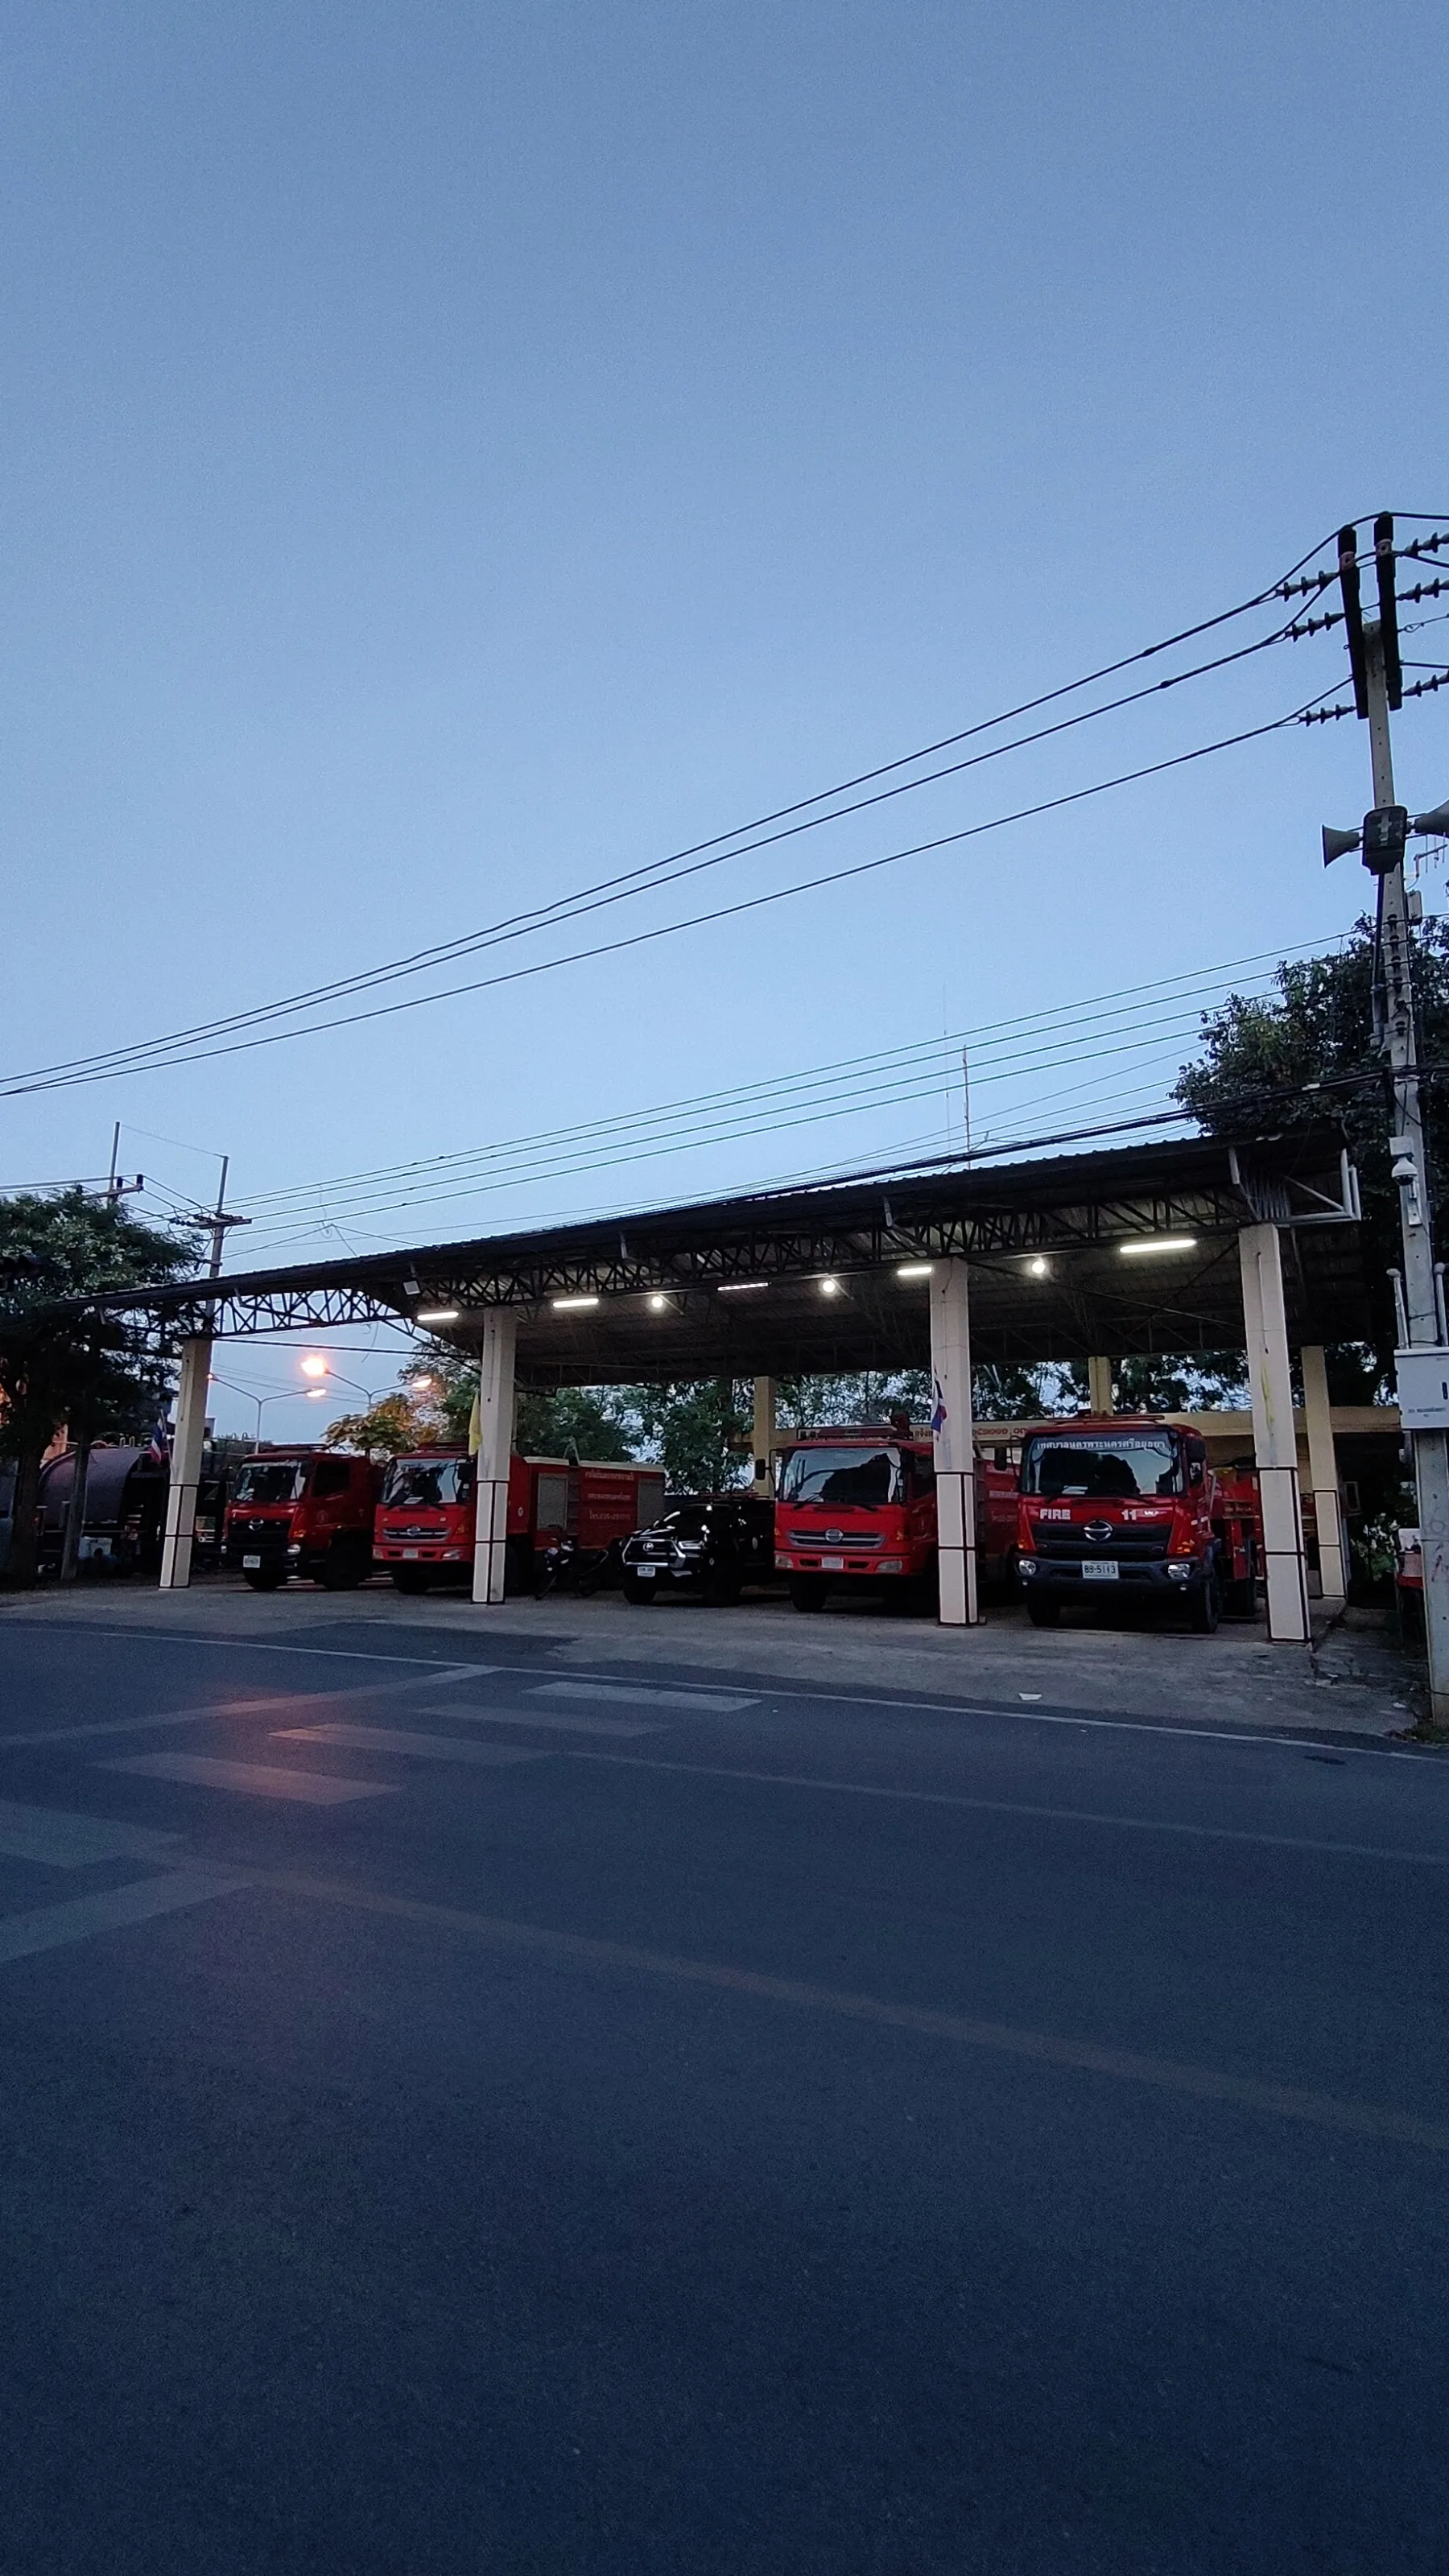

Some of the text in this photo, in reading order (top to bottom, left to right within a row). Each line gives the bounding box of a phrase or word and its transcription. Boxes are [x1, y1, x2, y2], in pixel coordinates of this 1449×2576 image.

[1037, 1438, 1166, 1450] เทศบาลนครพระนครศรีอยุธยา
[1039, 1509, 1071, 1520] FIRE
[1121, 1509, 1137, 1521] 11
